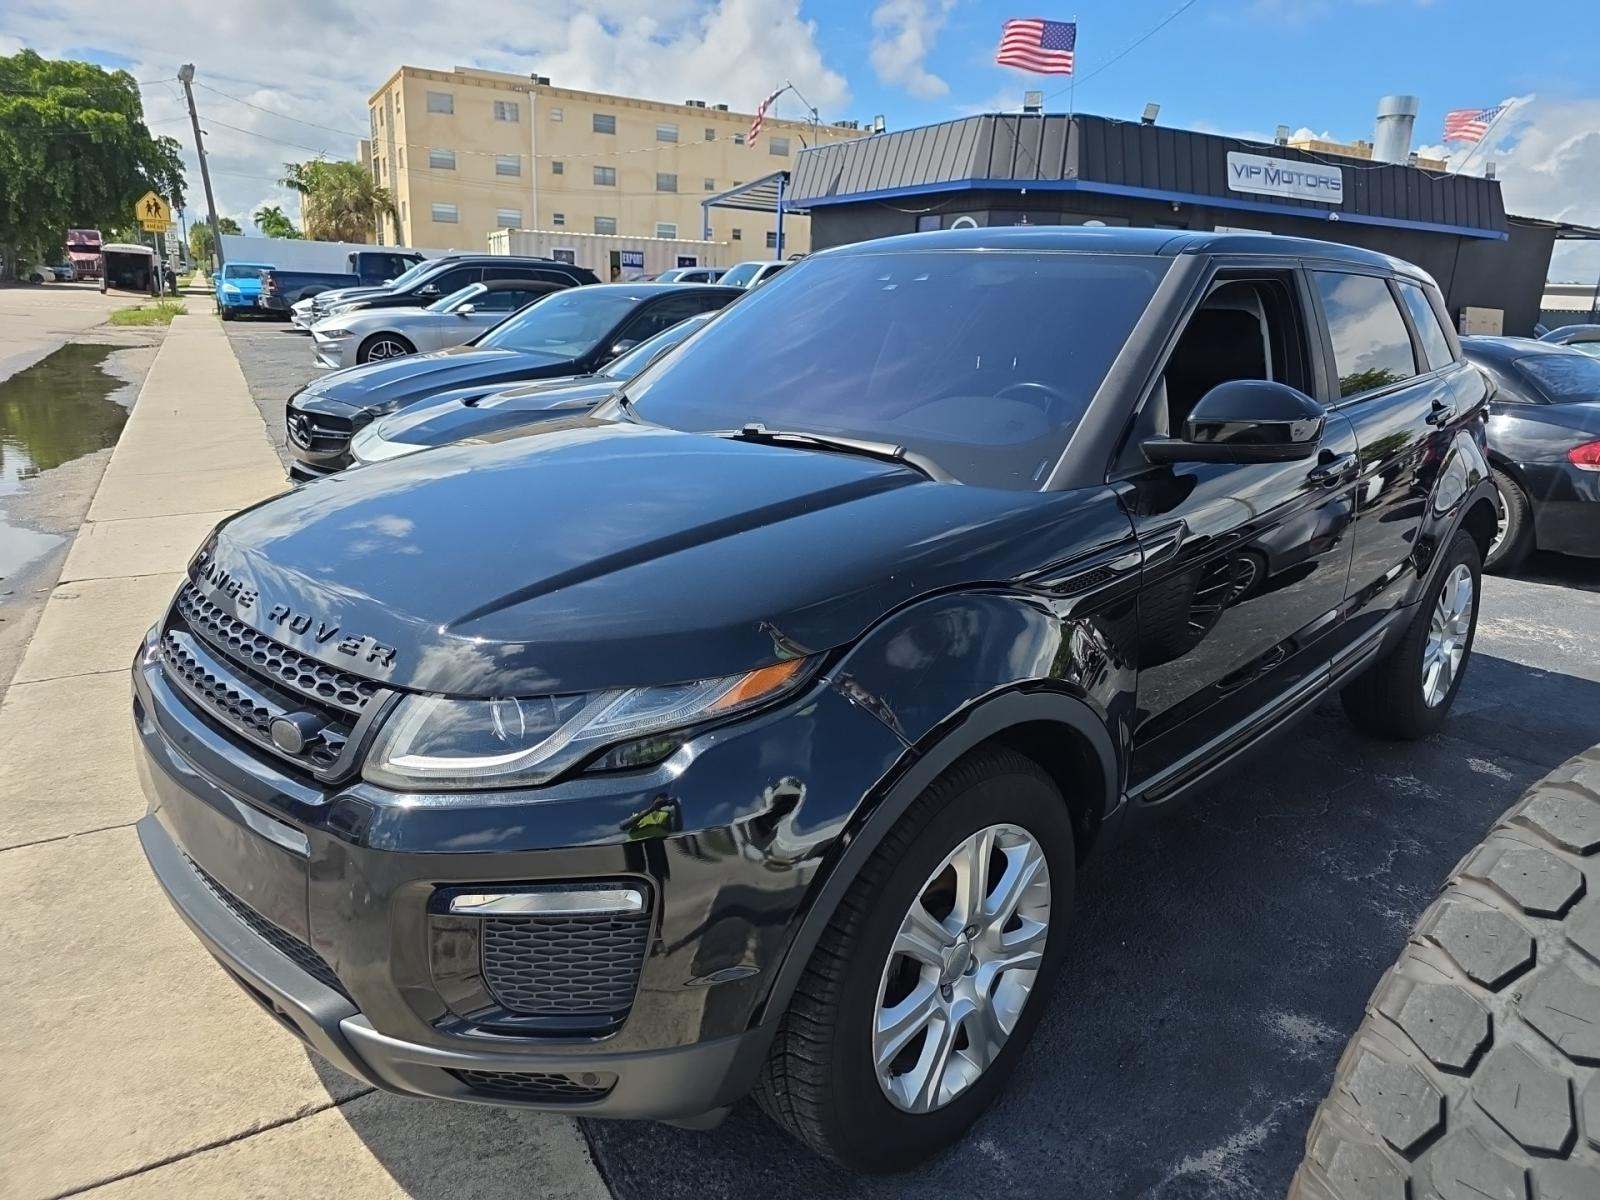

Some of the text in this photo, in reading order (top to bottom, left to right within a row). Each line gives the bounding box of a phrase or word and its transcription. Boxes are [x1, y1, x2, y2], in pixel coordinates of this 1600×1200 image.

[1231, 163, 1262, 179] VIP
[622, 252, 643, 265] EXPORT
[267, 603, 397, 668] ROVER
